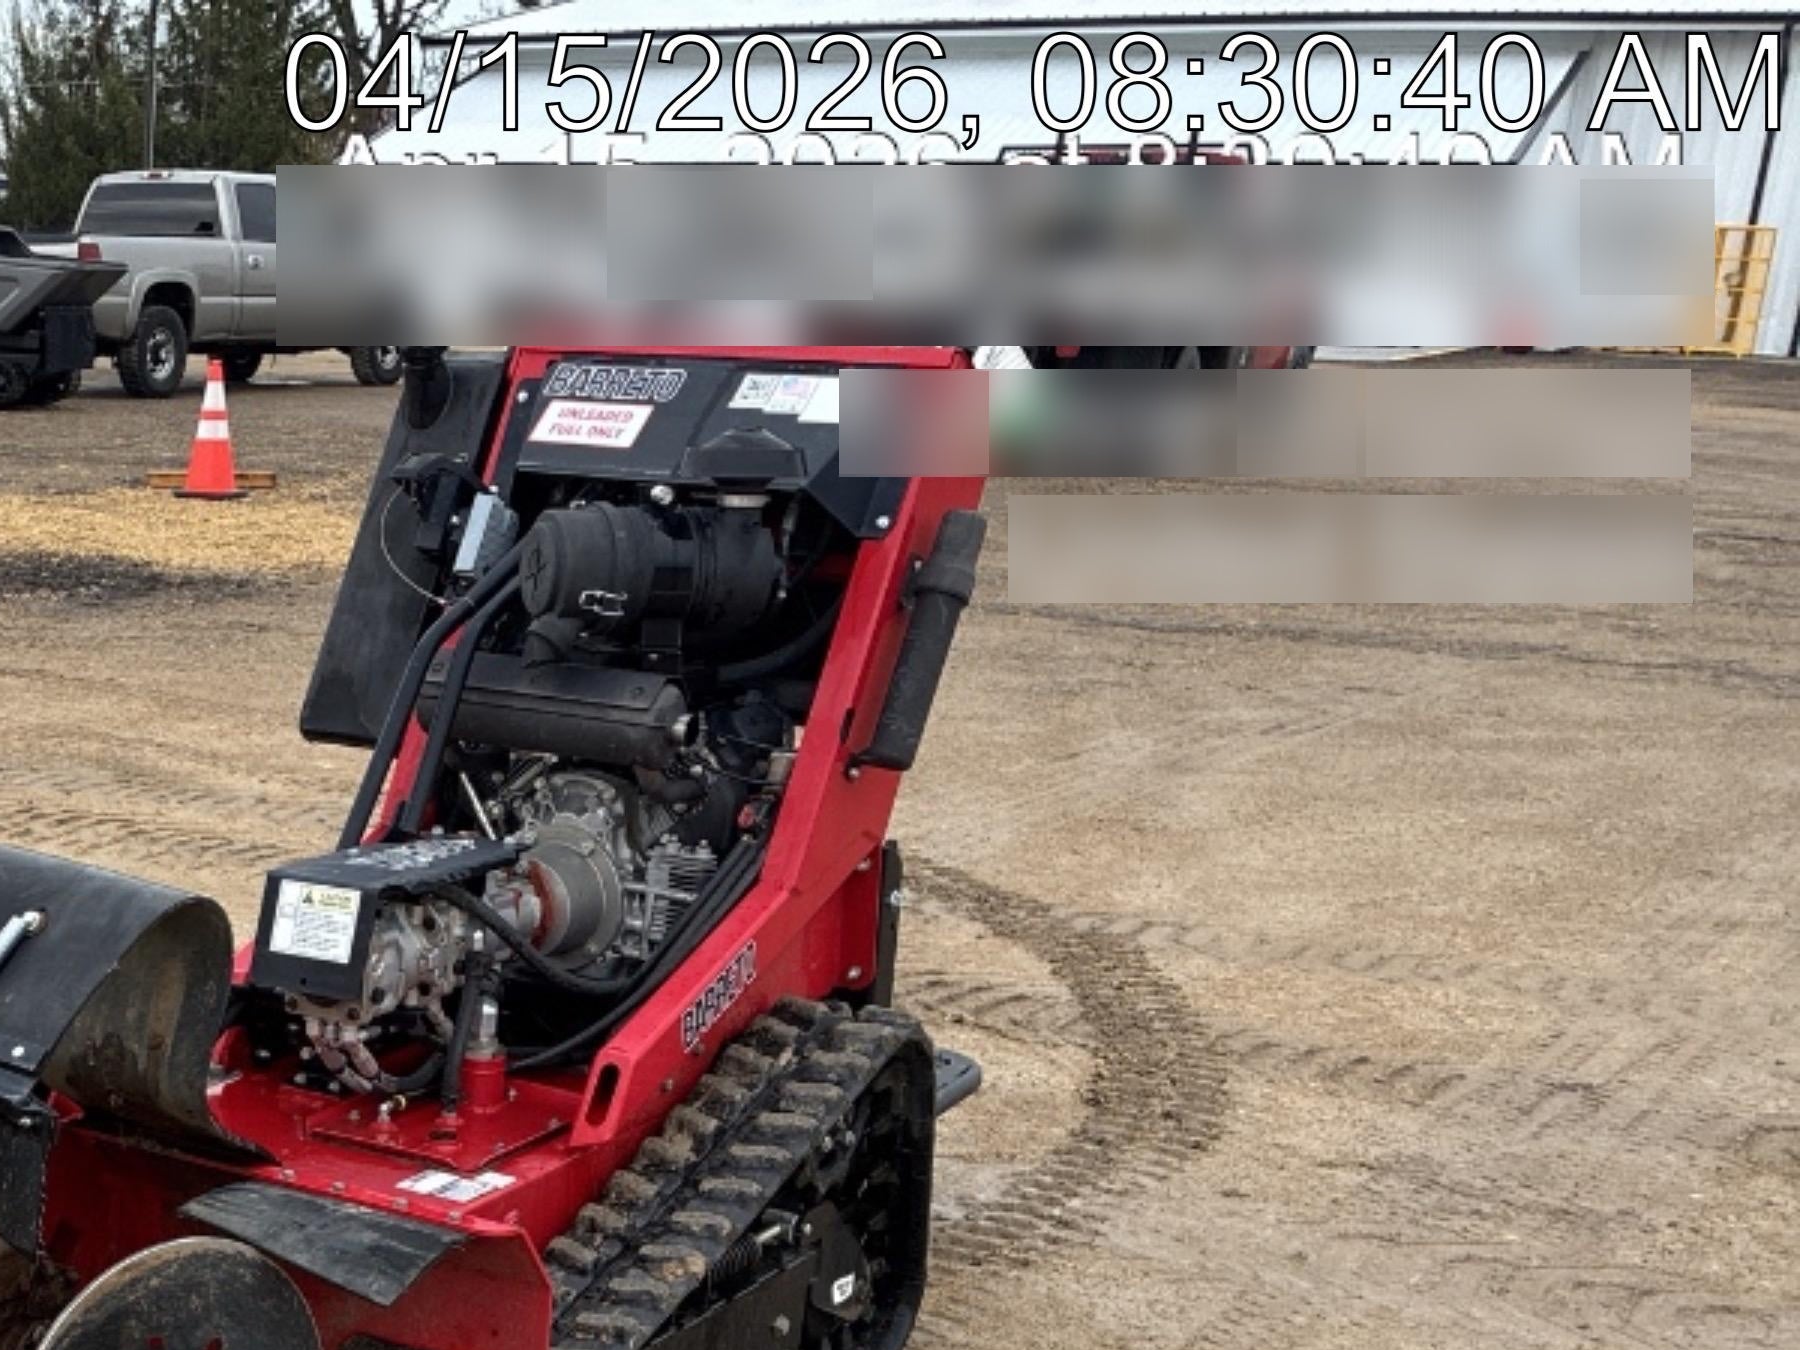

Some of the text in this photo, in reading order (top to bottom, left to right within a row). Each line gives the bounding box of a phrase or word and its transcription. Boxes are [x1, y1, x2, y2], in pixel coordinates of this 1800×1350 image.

[542, 363, 688, 402] BARRETO
[556, 407, 635, 423] UNLEADED
[548, 423, 625, 439] FUEL ONLY
[680, 938, 757, 1054] BARRETO
